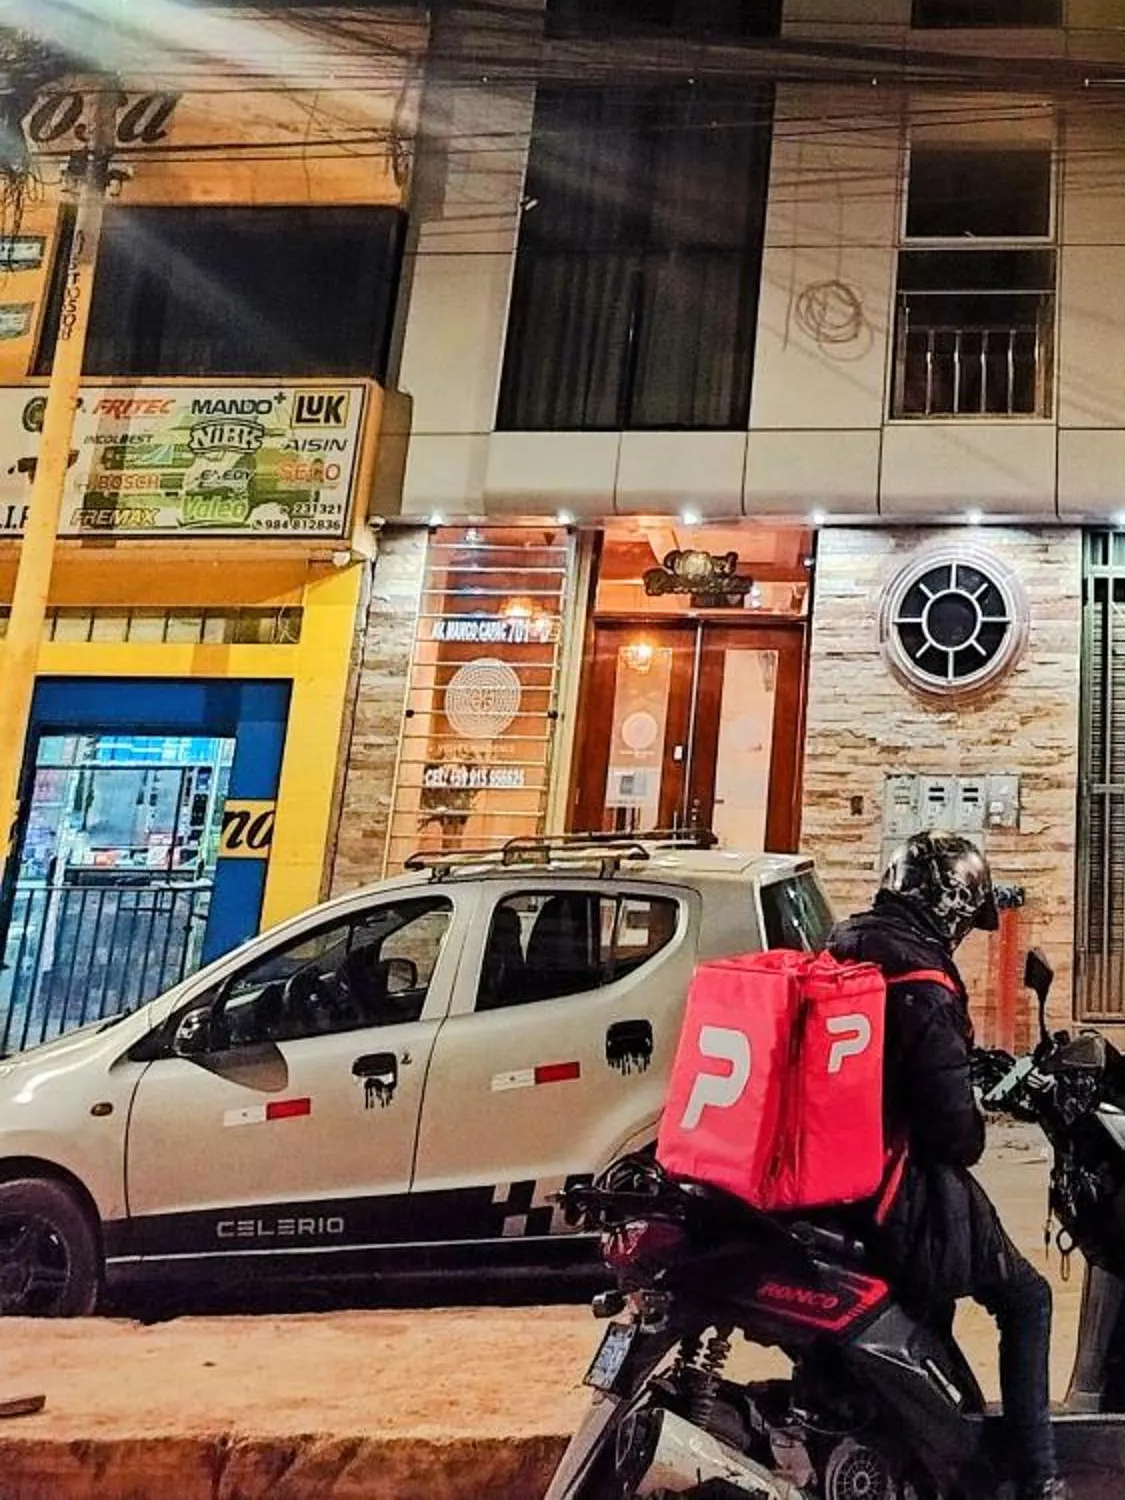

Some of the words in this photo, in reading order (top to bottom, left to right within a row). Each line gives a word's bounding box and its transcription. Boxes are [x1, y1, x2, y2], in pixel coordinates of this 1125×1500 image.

[92, 399, 176, 420] FRITEC
[281, 438, 348, 452] AISIN
[99, 474, 160, 489] BOSCH
[71, 508, 160, 527] FREMAX
[264, 520, 289, 530] 984
[216, 1217, 345, 1238] CELERIO
